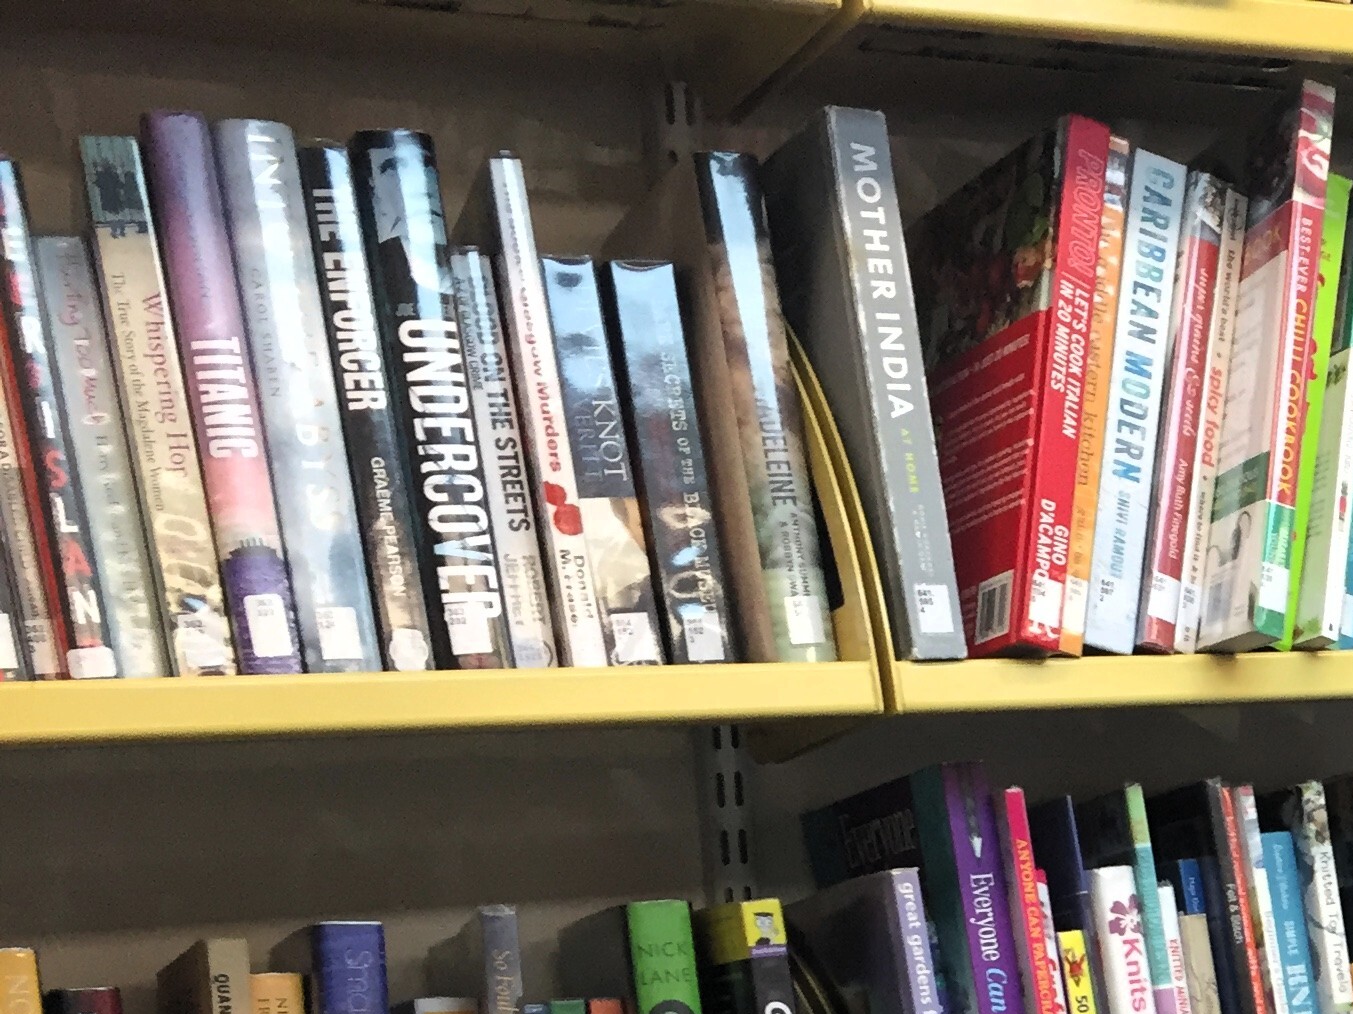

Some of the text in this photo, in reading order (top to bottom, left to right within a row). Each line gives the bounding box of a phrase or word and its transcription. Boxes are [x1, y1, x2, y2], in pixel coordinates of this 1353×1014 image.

[1122, 165, 1177, 345] CARIBBEAN
[843, 138, 901, 301] MOTHER
[872, 309, 917, 420] INDIA
[902, 451, 922, 495] HOME
[1061, 285, 1093, 439] LET'S COOK ITALIAN
[190, 336, 258, 459] TITANIC
[589, 397, 627, 485] KNOT
[1108, 350, 1155, 484] MODERN
[366, 455, 406, 600] GRAEME PEARSON
[896, 880, 922, 930] great
[963, 870, 1006, 964] Everyone
[641, 967, 693, 986] LANE
[906, 932, 937, 1006] gardens
[984, 966, 1012, 1014] Can
